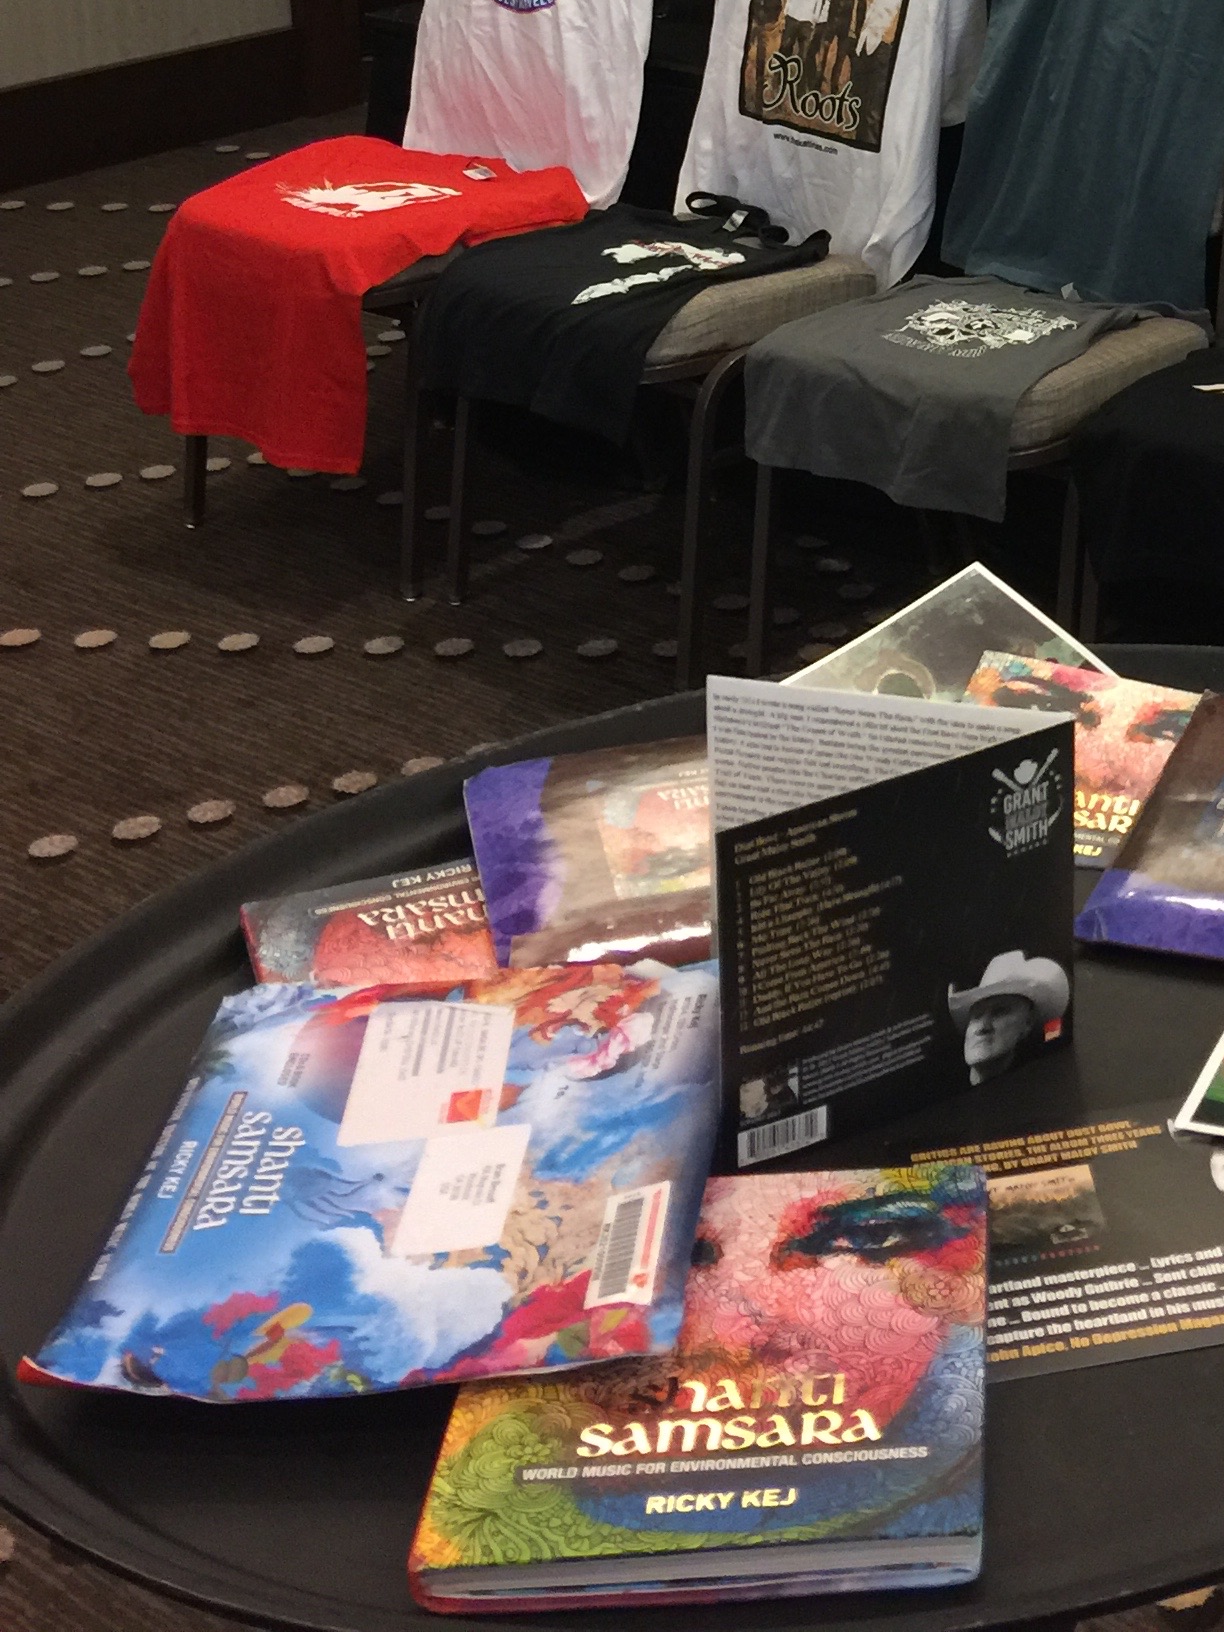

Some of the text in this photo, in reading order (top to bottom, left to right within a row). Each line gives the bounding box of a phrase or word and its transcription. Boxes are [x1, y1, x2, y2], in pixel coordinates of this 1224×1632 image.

[762, 52, 862, 130] Roots
[1004, 781, 1050, 814] GRANT
[1005, 819, 1048, 850] SMITH
[392, 864, 472, 889] RICKY KEJ
[960, 1120, 1132, 1156] ARE RAVING ABOUT DUST BOWL
[1026, 1144, 1047, 1156] THE
[1126, 1125, 1162, 1140] YEARS
[239, 1125, 307, 1216] shanti
[1003, 1159, 1019, 1171] BY
[1021, 1155, 1058, 1168] GRANT
[1061, 1147, 1098, 1161] MALOY
[1100, 1140, 1138, 1154] SMITH
[1044, 1262, 1136, 1286] masterpiece
[1150, 1252, 1193, 1268] Lyrics
[1021, 1304, 1071, 1322] Bound
[1089, 1293, 1149, 1311] become
[1163, 1281, 1217, 1299] classic
[1031, 1287, 1082, 1304] Woody
[1084, 1277, 1139, 1295] Guthrie
[1153, 1269, 1187, 1284] Sent
[1074, 1308, 1147, 1331] heartland
[522, 1446, 929, 1481] WORLD MUSIC FOR ENVIRONMENTAL CONSCIOUSNESS
[645, 1488, 797, 1515] RICKY KEJ
